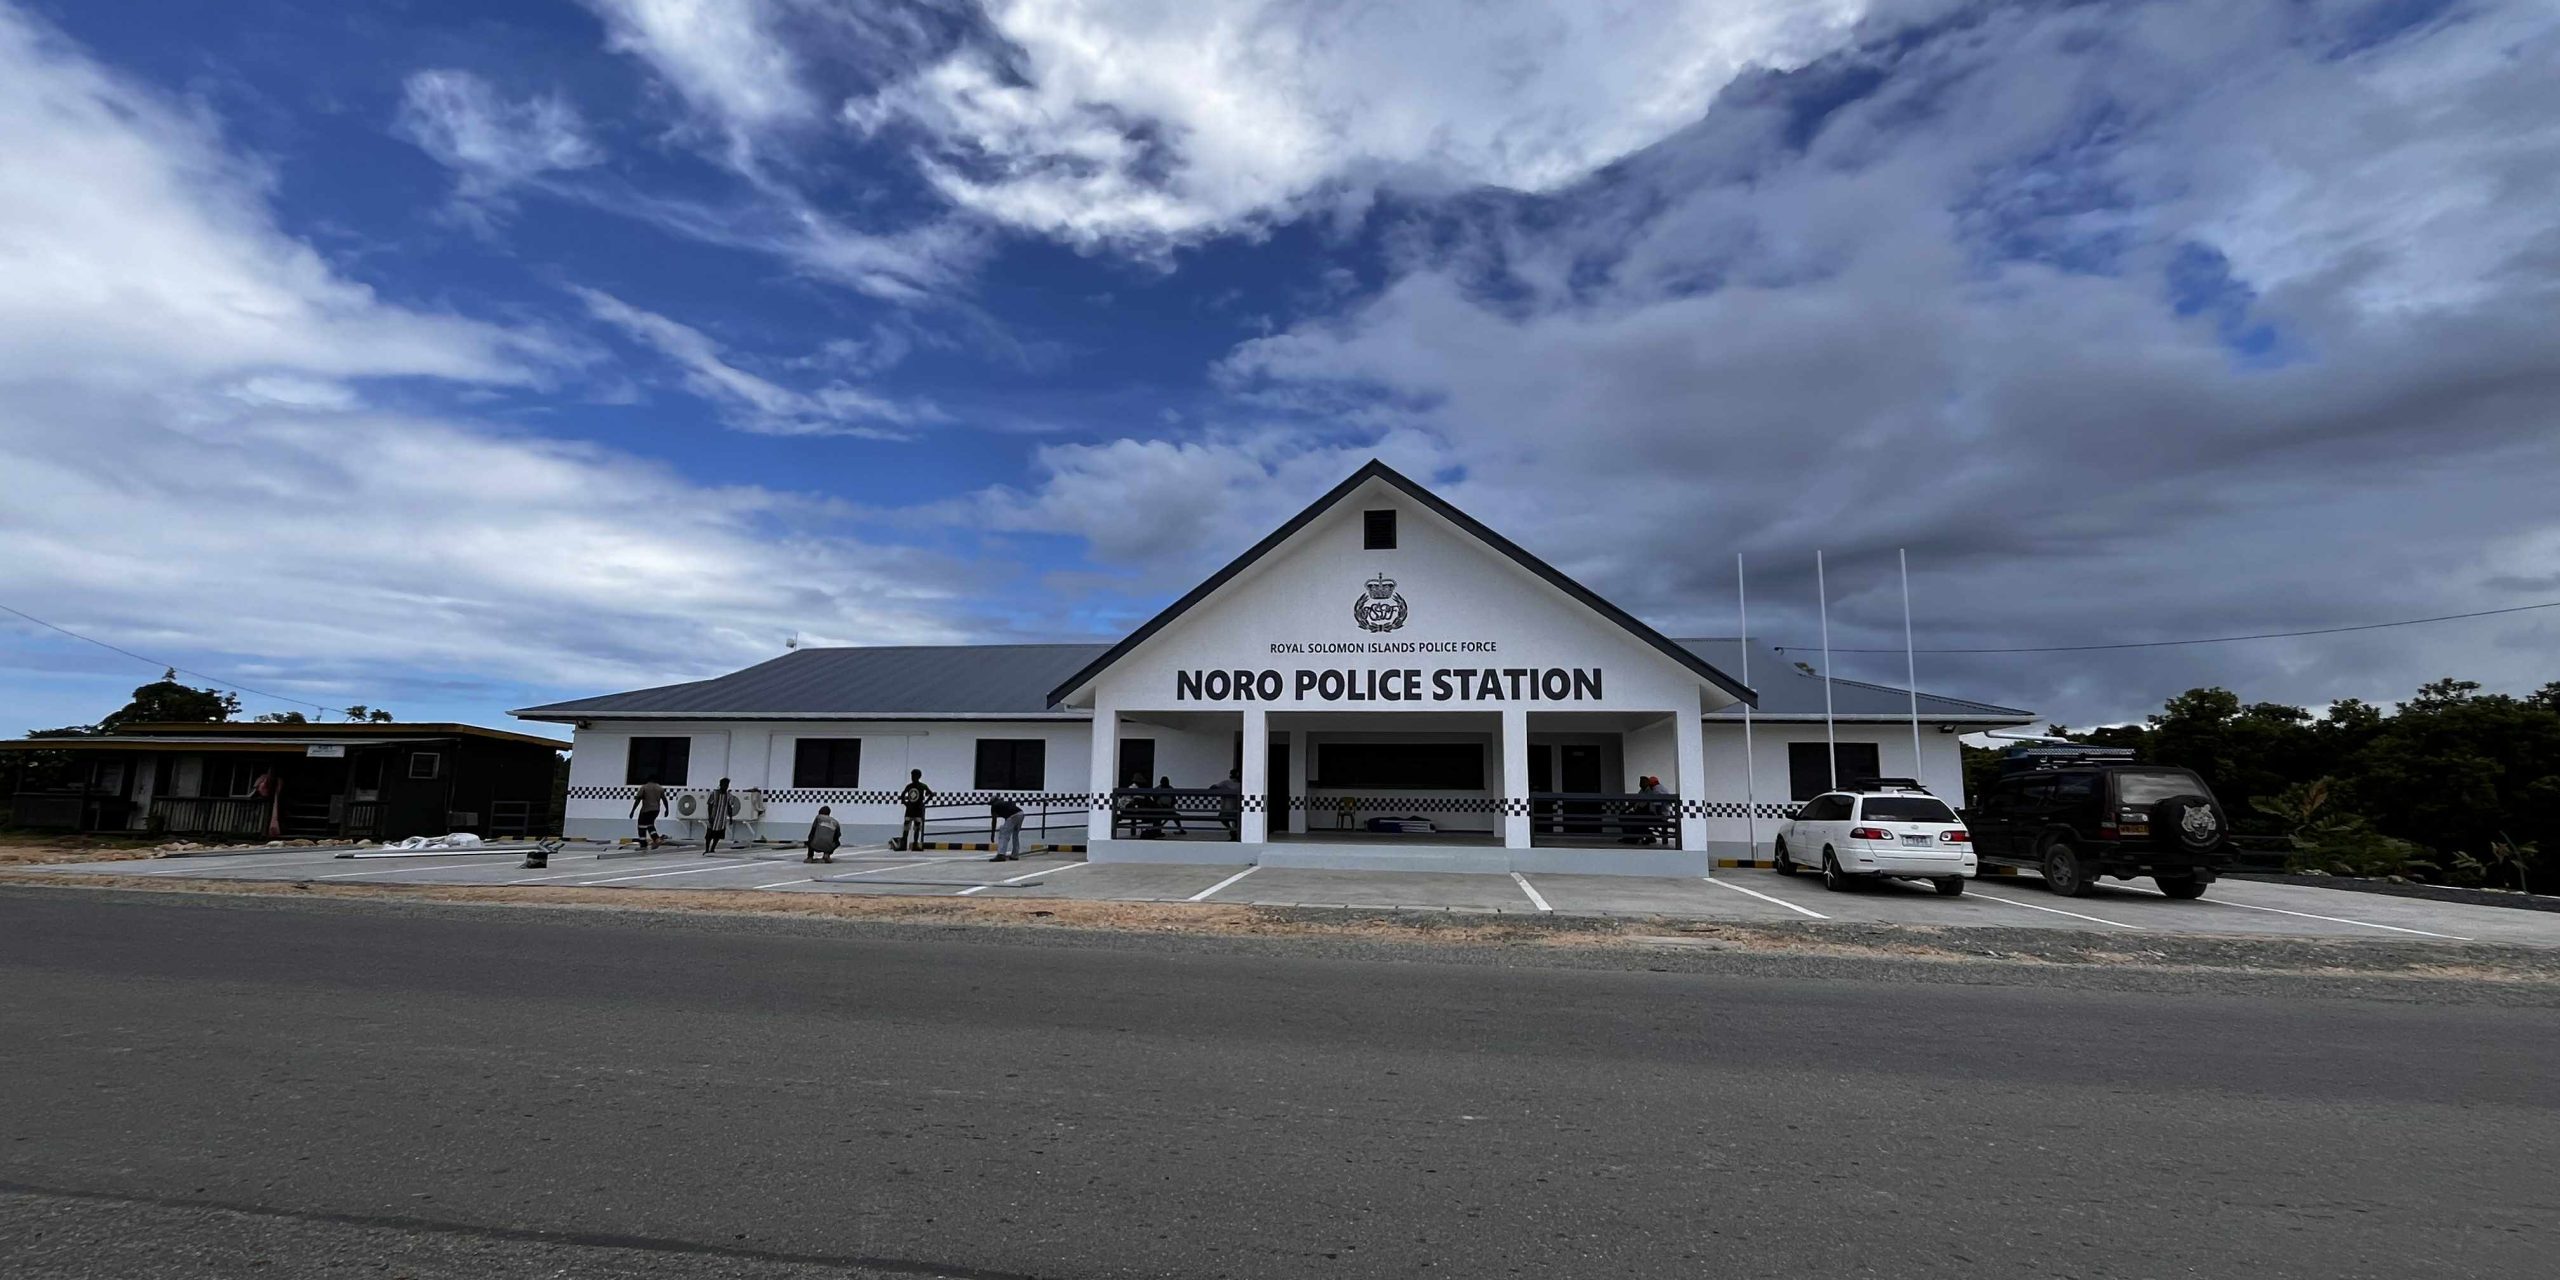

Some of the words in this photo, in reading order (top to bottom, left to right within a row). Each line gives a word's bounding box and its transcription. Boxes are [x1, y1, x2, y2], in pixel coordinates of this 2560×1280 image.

[1270, 643, 1304, 653] ROYAL
[1308, 643, 1364, 653] SOLOMON
[1368, 642, 1415, 652] ISLANDS
[1419, 642, 1457, 652] POLICE
[1461, 641, 1497, 652] FORCE
[1176, 669, 1284, 701] NORO
[1295, 669, 1422, 701] POLICE
[1432, 668, 1603, 701] STATION
